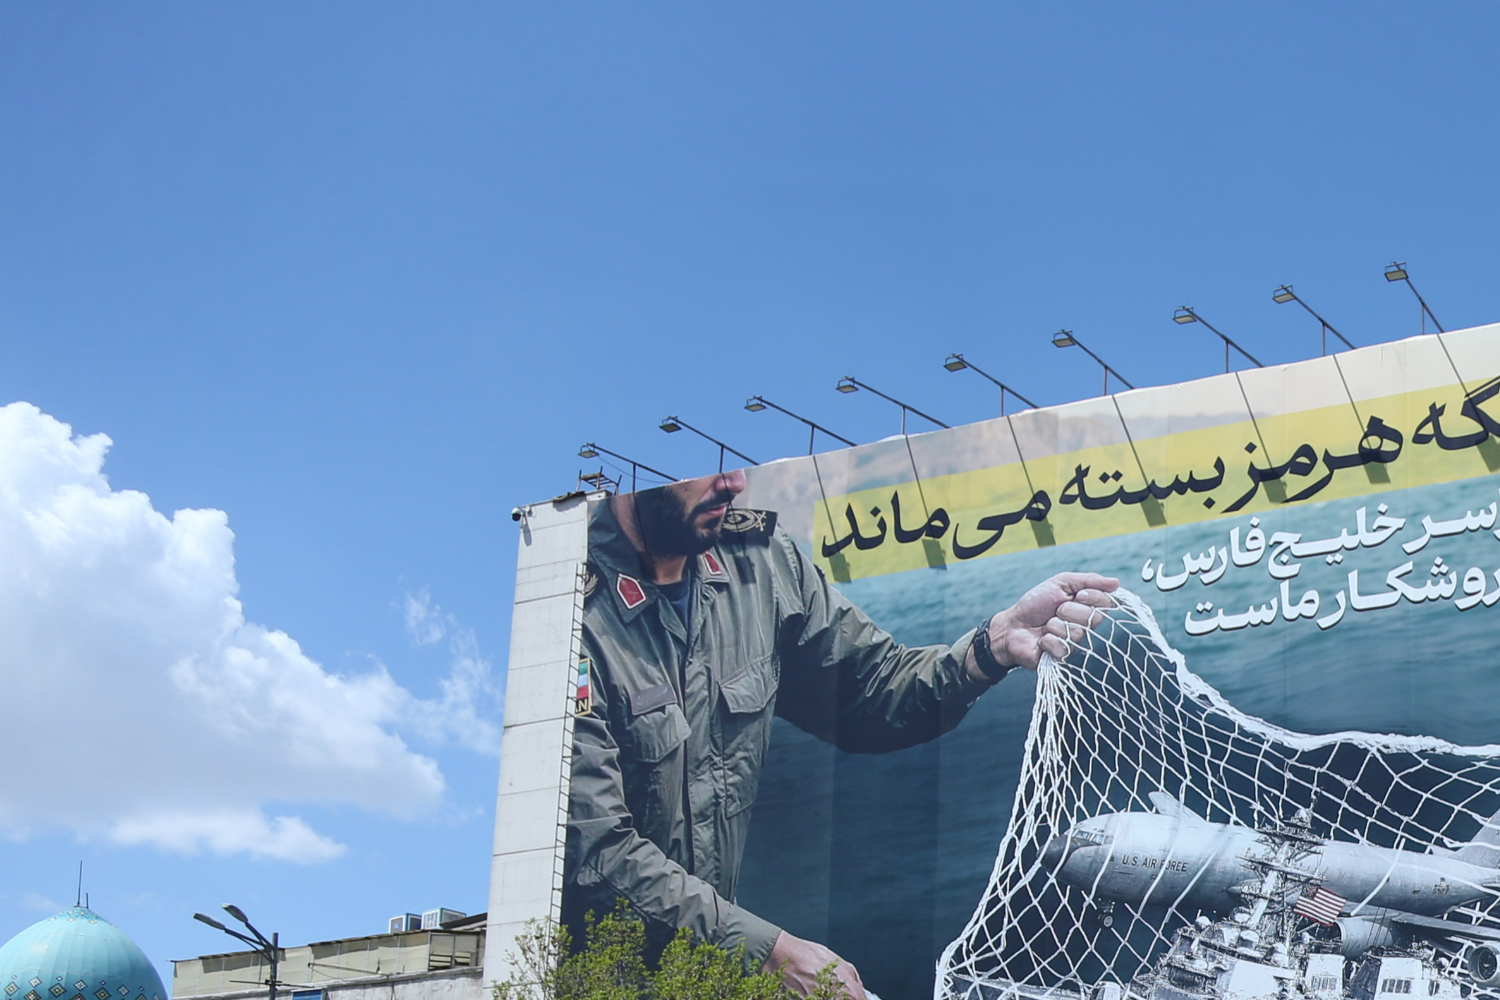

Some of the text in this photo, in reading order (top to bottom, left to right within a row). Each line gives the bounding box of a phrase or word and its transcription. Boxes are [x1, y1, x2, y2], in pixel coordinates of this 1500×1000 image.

[1059, 455, 1225, 511] بسته
[1220, 415, 1404, 514] هرمز
[1267, 502, 1407, 579] خلیج
[1184, 580, 1320, 636] ماست
[1316, 556, 1458, 629] شکار
[1142, 857, 1157, 869] AIR
